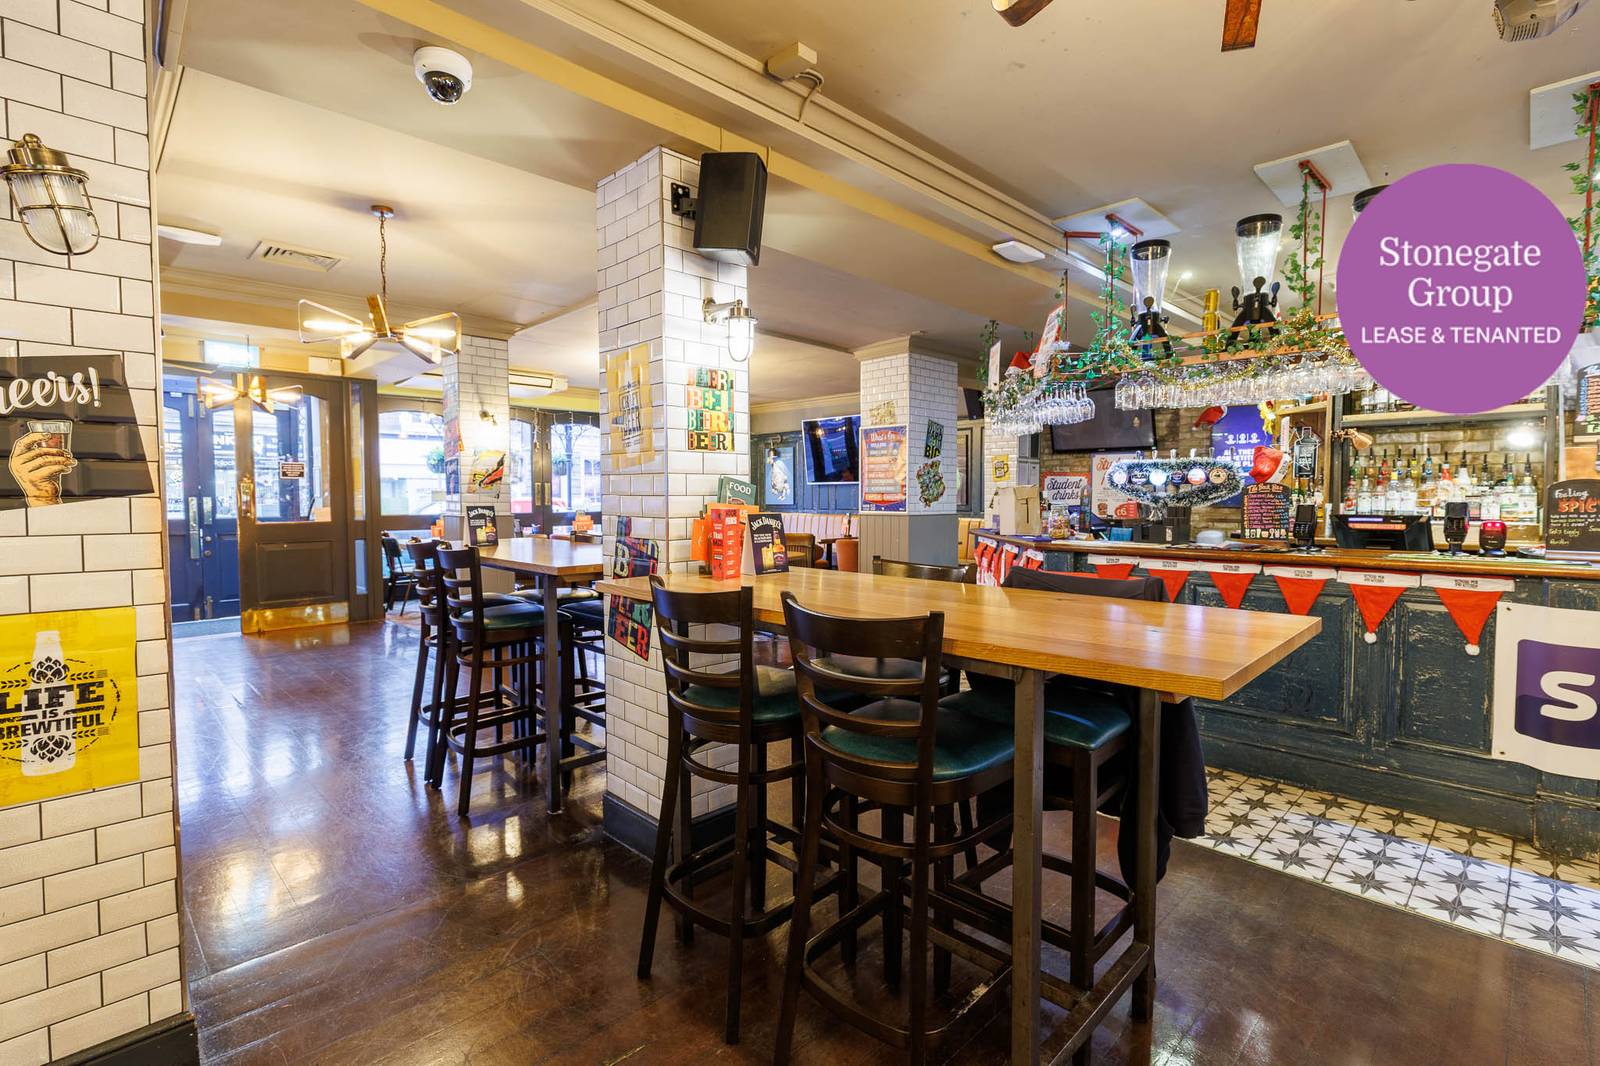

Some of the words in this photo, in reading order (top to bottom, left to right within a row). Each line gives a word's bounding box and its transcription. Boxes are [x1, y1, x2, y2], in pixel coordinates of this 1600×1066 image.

[688, 431, 728, 451] BEER
[729, 481, 752, 496] FOOD
[1047, 477, 1082, 491] Student
[1052, 490, 1079, 501] drinks
[1555, 488, 1590, 500] Feeling
[750, 517, 762, 531] JACK
[0, 681, 105, 714] LIFE
[42, 709, 59, 720] IS
